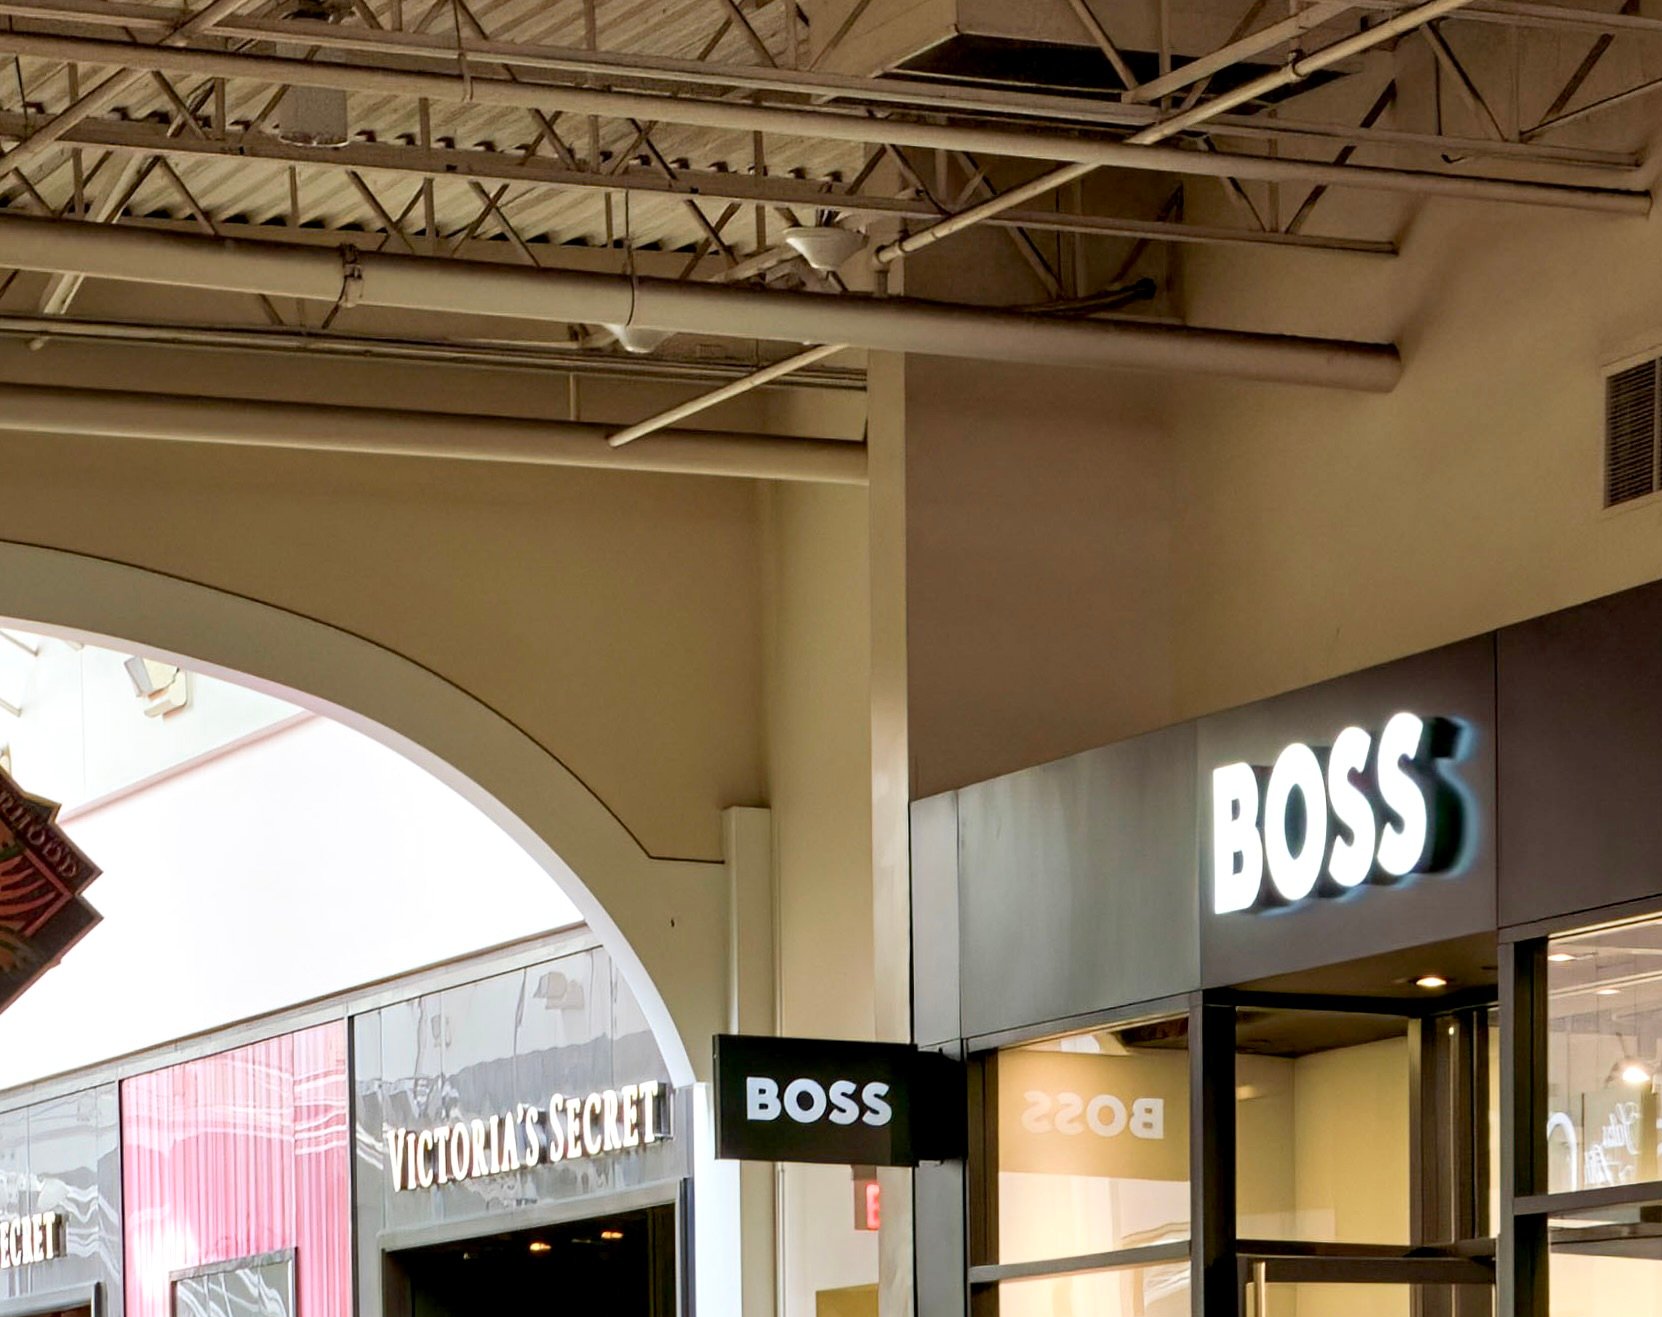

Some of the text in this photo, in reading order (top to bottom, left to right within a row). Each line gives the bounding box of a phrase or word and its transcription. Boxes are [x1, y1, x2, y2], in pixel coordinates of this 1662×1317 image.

[1213, 711, 1430, 915] BOSS
[386, 1079, 659, 1193] VICTORIA'S SECRET
[746, 1076, 893, 1127] BOSS
[0, 1210, 56, 1270] ECRET
